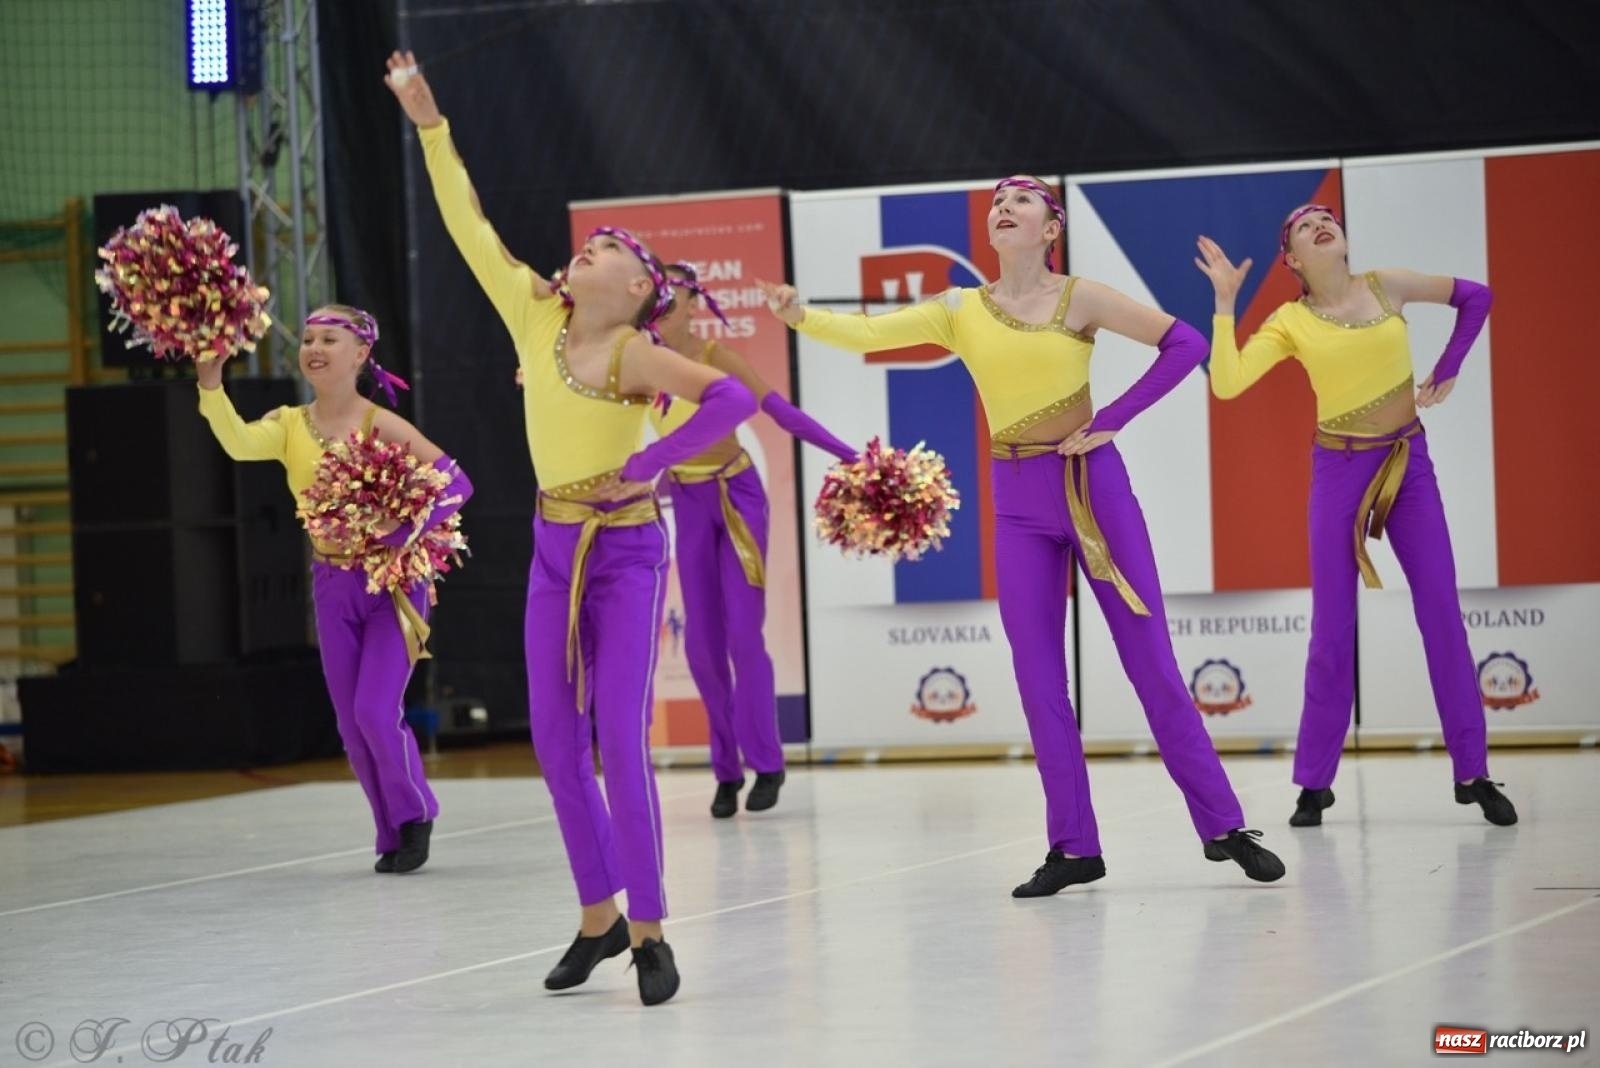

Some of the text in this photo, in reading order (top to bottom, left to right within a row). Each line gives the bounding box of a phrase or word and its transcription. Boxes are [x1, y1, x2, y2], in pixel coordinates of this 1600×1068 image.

[695, 260, 742, 282] EAN
[1200, 614, 1306, 636] REPUBLIC
[1462, 607, 1545, 629] OLAND
[887, 624, 991, 646] SLOVAKIA
